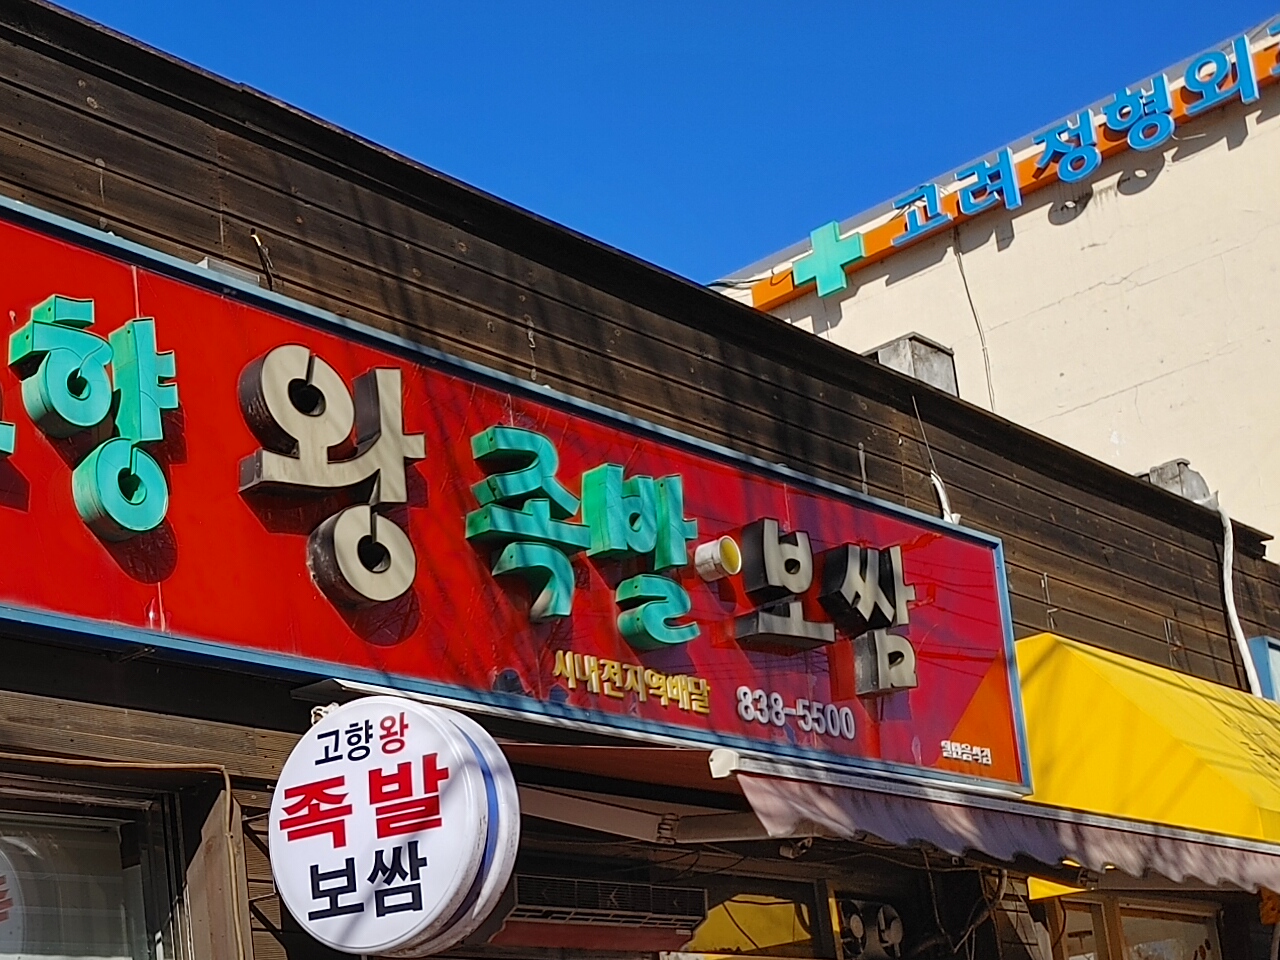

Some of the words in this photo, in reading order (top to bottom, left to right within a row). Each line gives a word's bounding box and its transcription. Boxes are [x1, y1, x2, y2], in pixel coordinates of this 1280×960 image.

[891, 146, 1023, 247] 고려
[1033, 22, 1280, 184] 정형외
[239, 344, 425, 602] 왕
[737, 685, 856, 740] 838-5500
[279, 752, 449, 849] 족발
[308, 840, 427, 921] 보쌈
